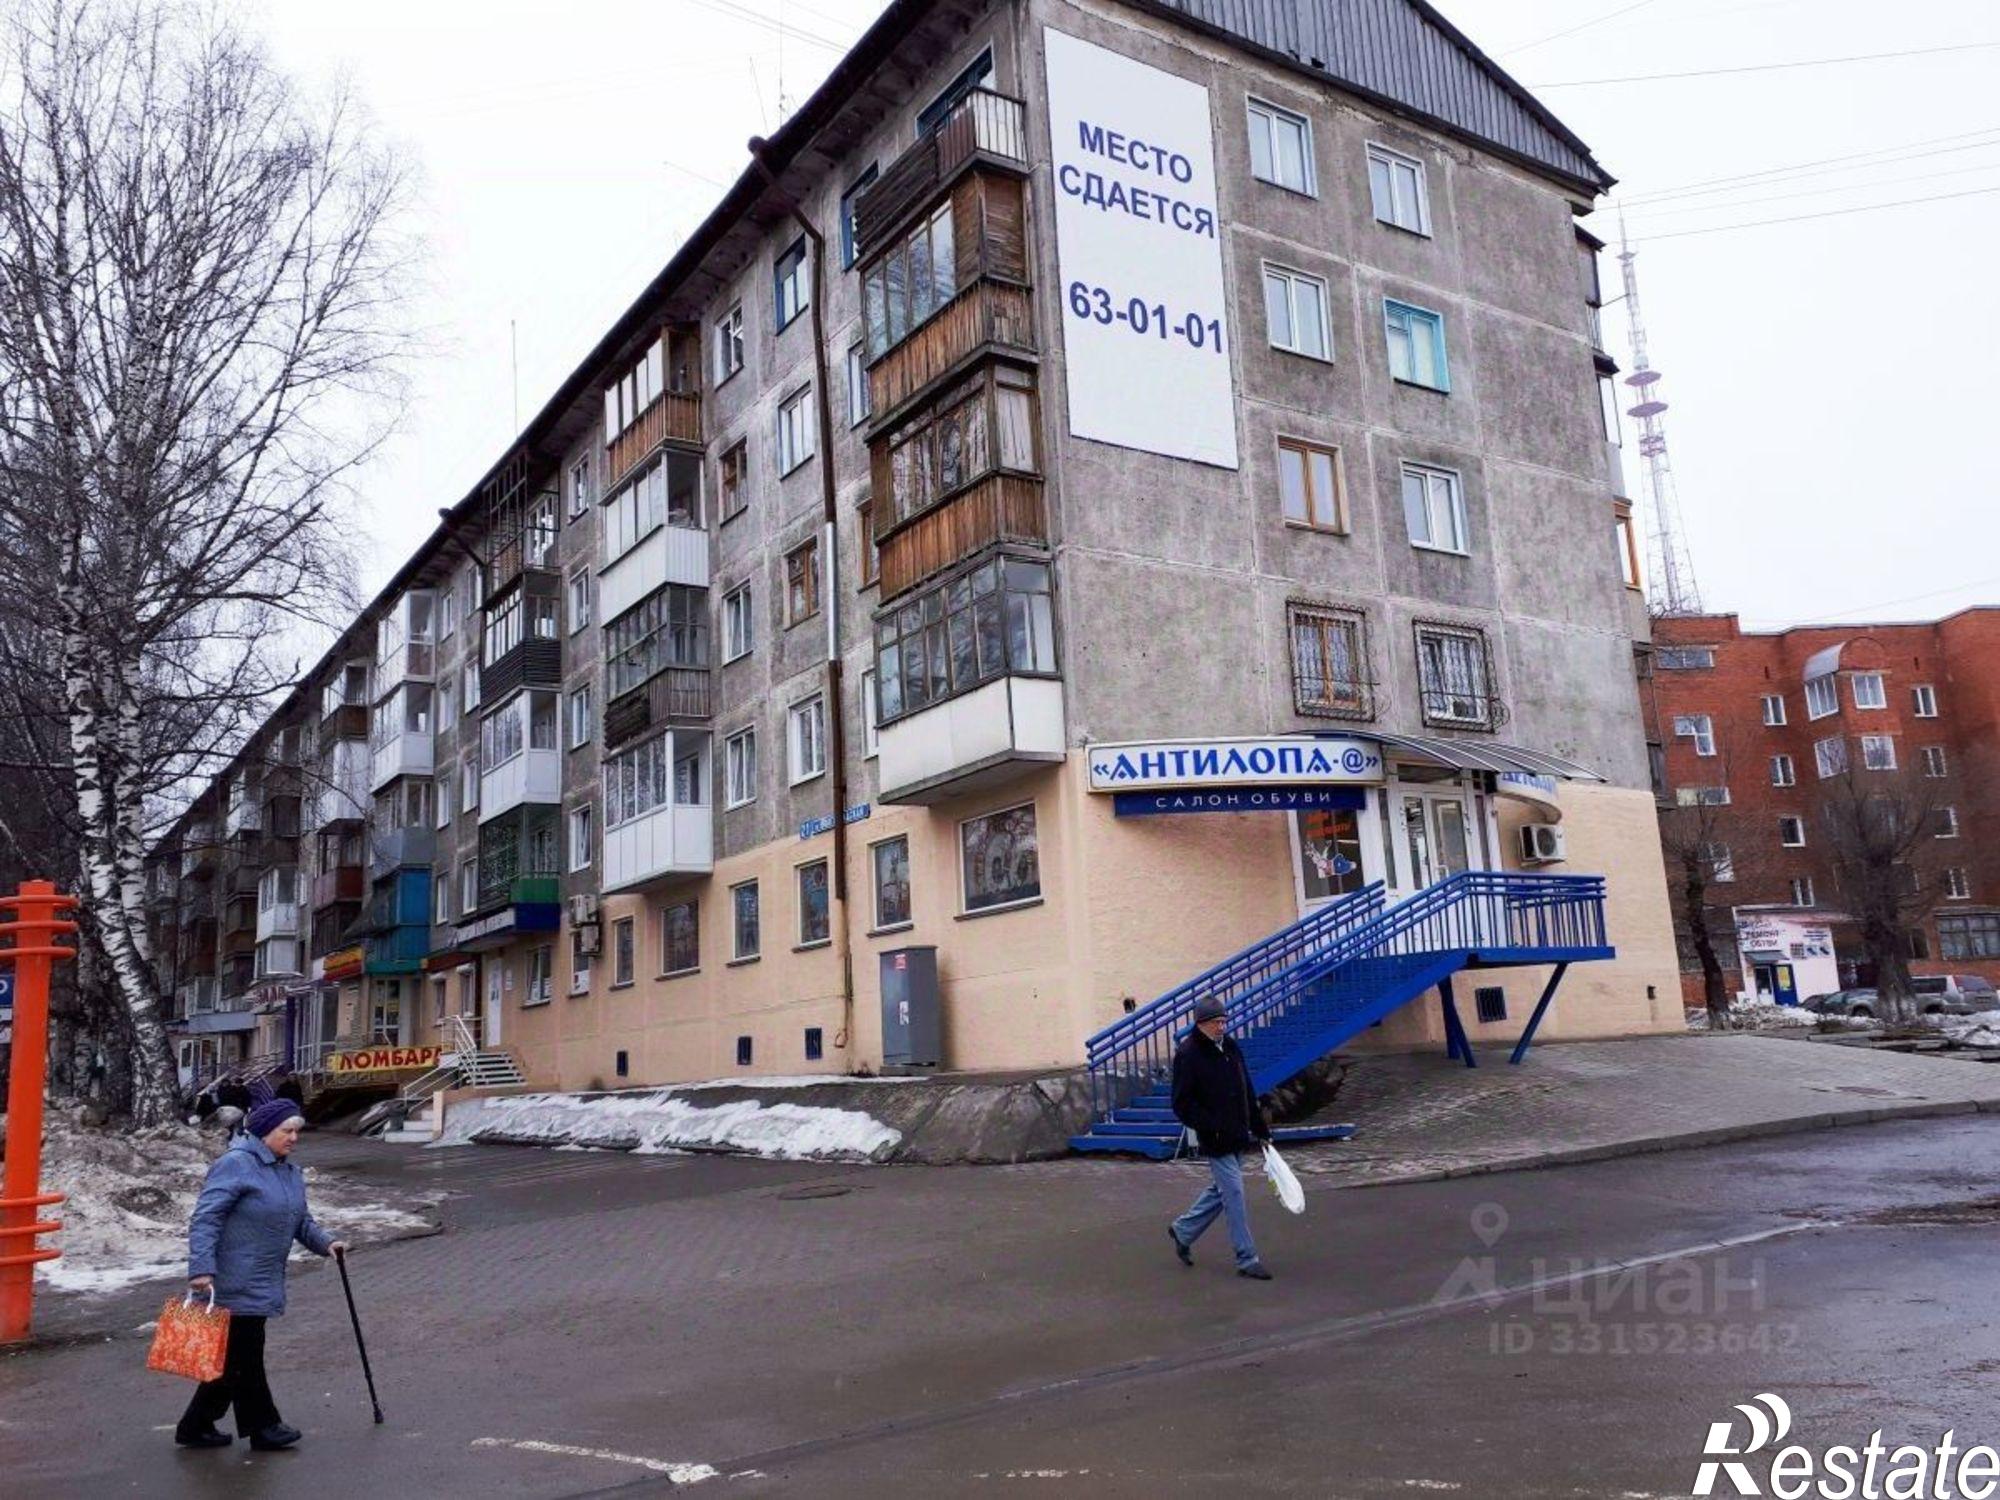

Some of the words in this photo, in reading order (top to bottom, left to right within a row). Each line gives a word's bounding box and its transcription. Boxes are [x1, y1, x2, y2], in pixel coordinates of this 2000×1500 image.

[1078, 120, 1192, 184] МЕСТО
[1059, 164, 1215, 239] СДАЕТСЯ
[1069, 281, 1222, 353] 63-01-01
[1155, 794, 1240, 809] САЛОН
[1251, 792, 1331, 806] ОБУВИ
